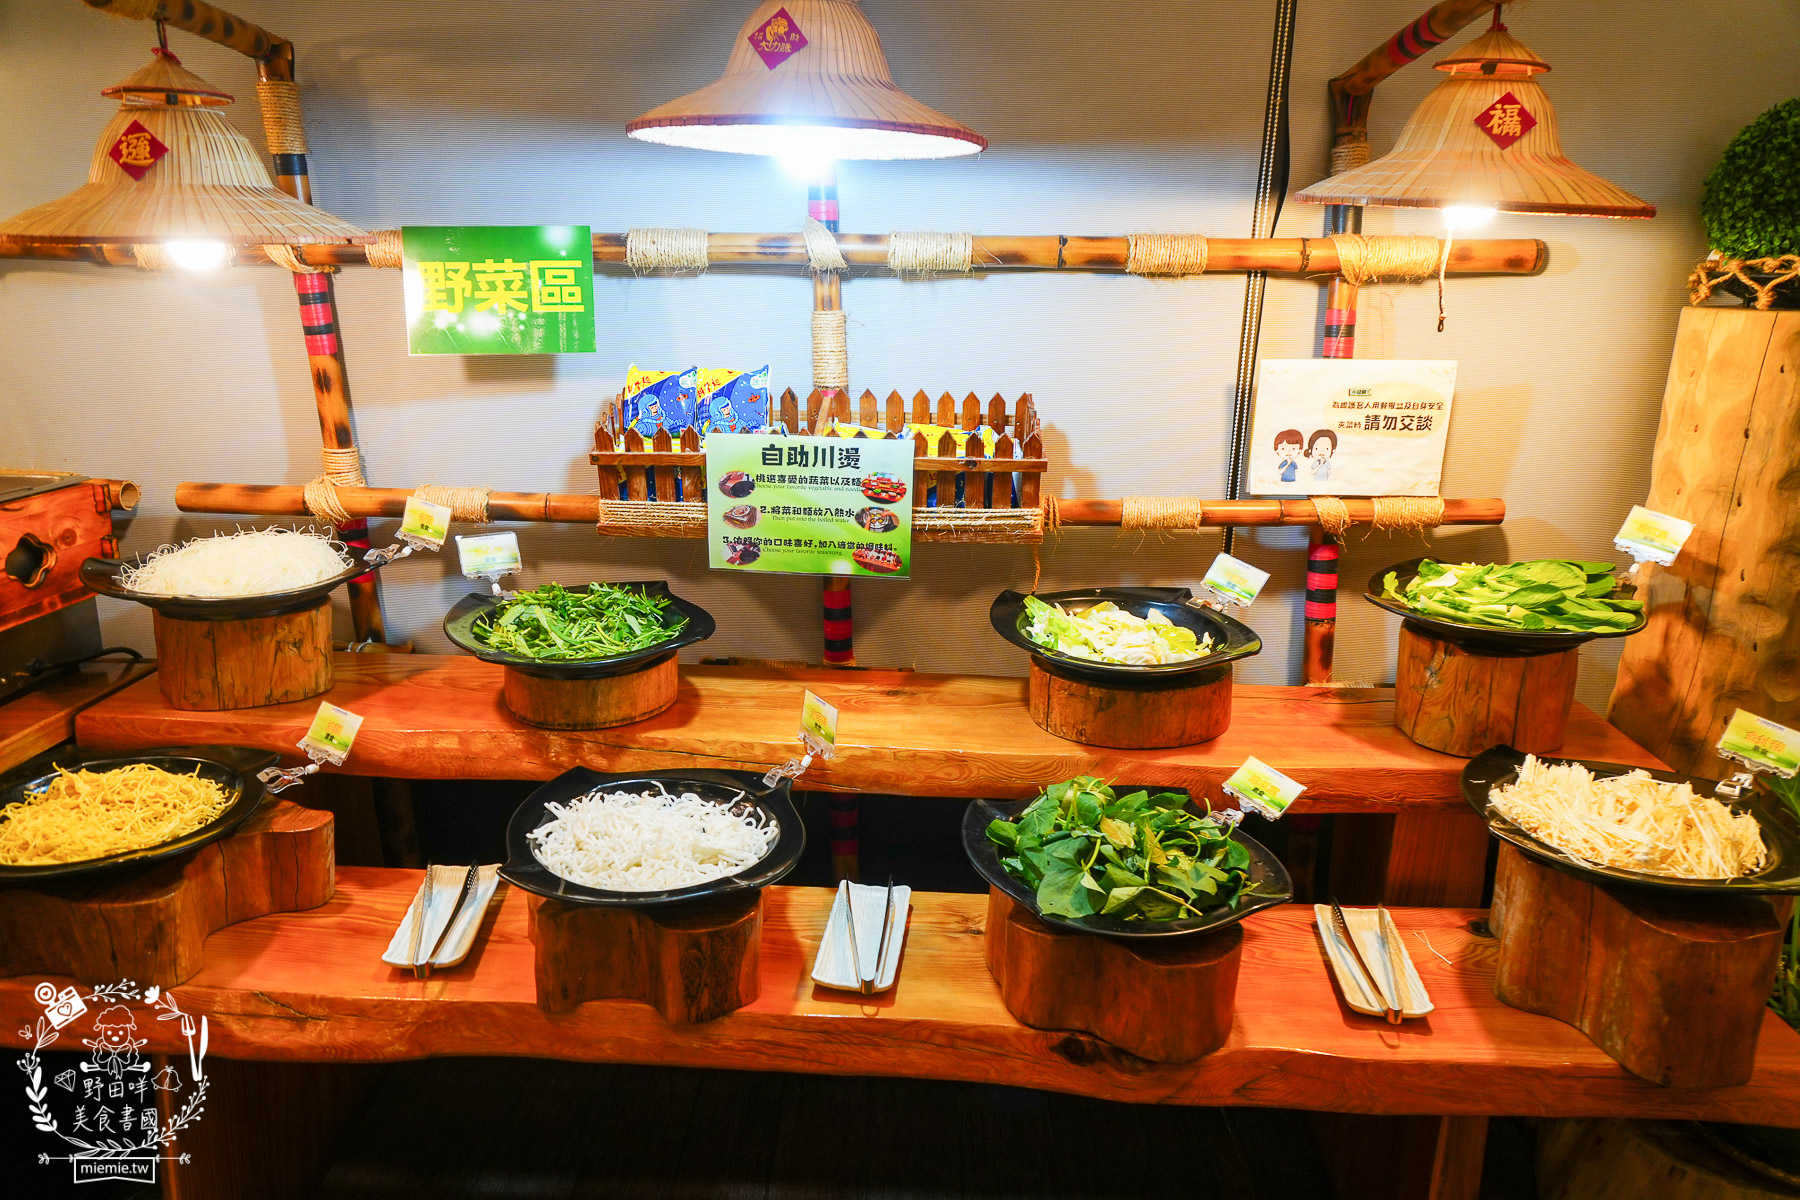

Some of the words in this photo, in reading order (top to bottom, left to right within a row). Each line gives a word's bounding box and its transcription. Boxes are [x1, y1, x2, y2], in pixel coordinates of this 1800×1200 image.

[417, 258, 585, 314] 野菜區
[1364, 414, 1433, 431] 請勿交談
